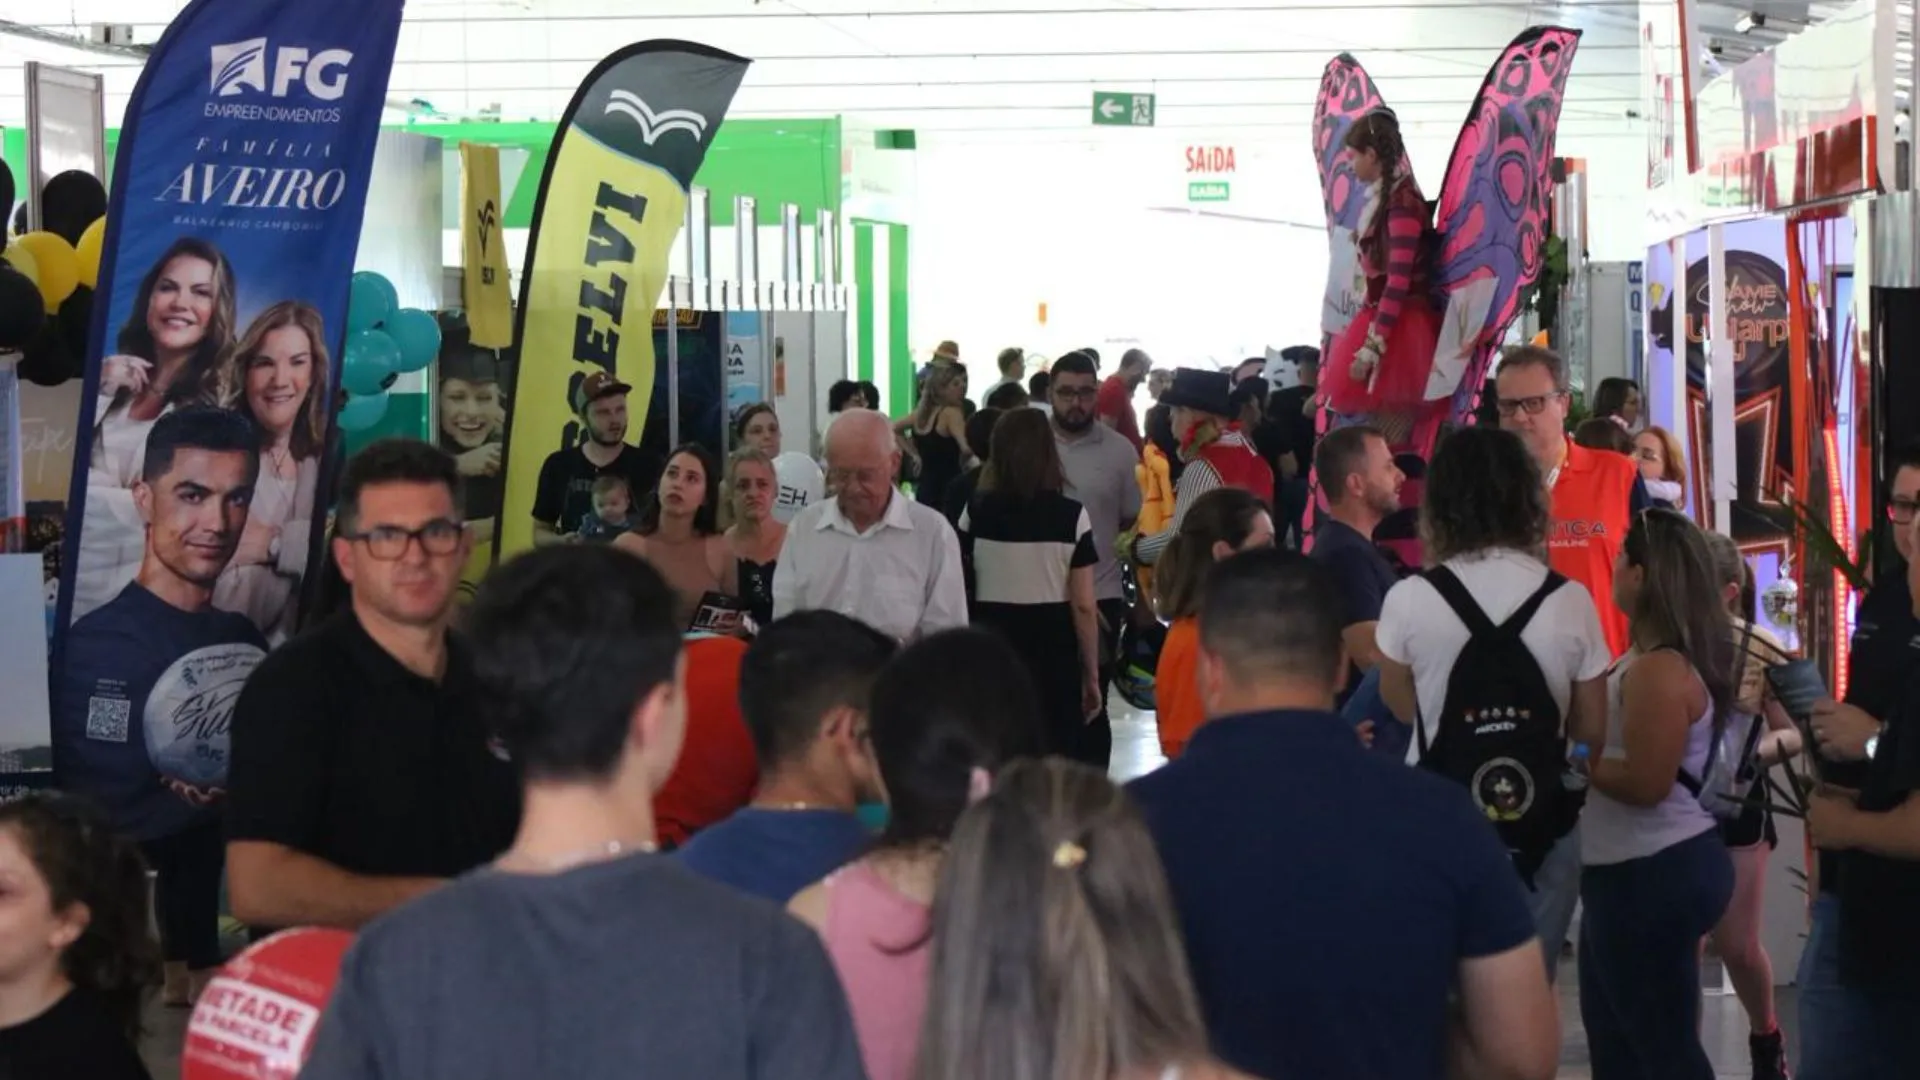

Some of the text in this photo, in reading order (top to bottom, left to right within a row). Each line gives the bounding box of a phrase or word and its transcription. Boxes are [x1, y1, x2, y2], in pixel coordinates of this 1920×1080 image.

[272, 47, 354, 100] FG
[204, 102, 341, 123] EMPREENDIMENTOS
[196, 136, 331, 158] FAMÍLIA
[1185, 146, 1236, 172] SAÍDA
[152, 162, 346, 210] AVEIRO
